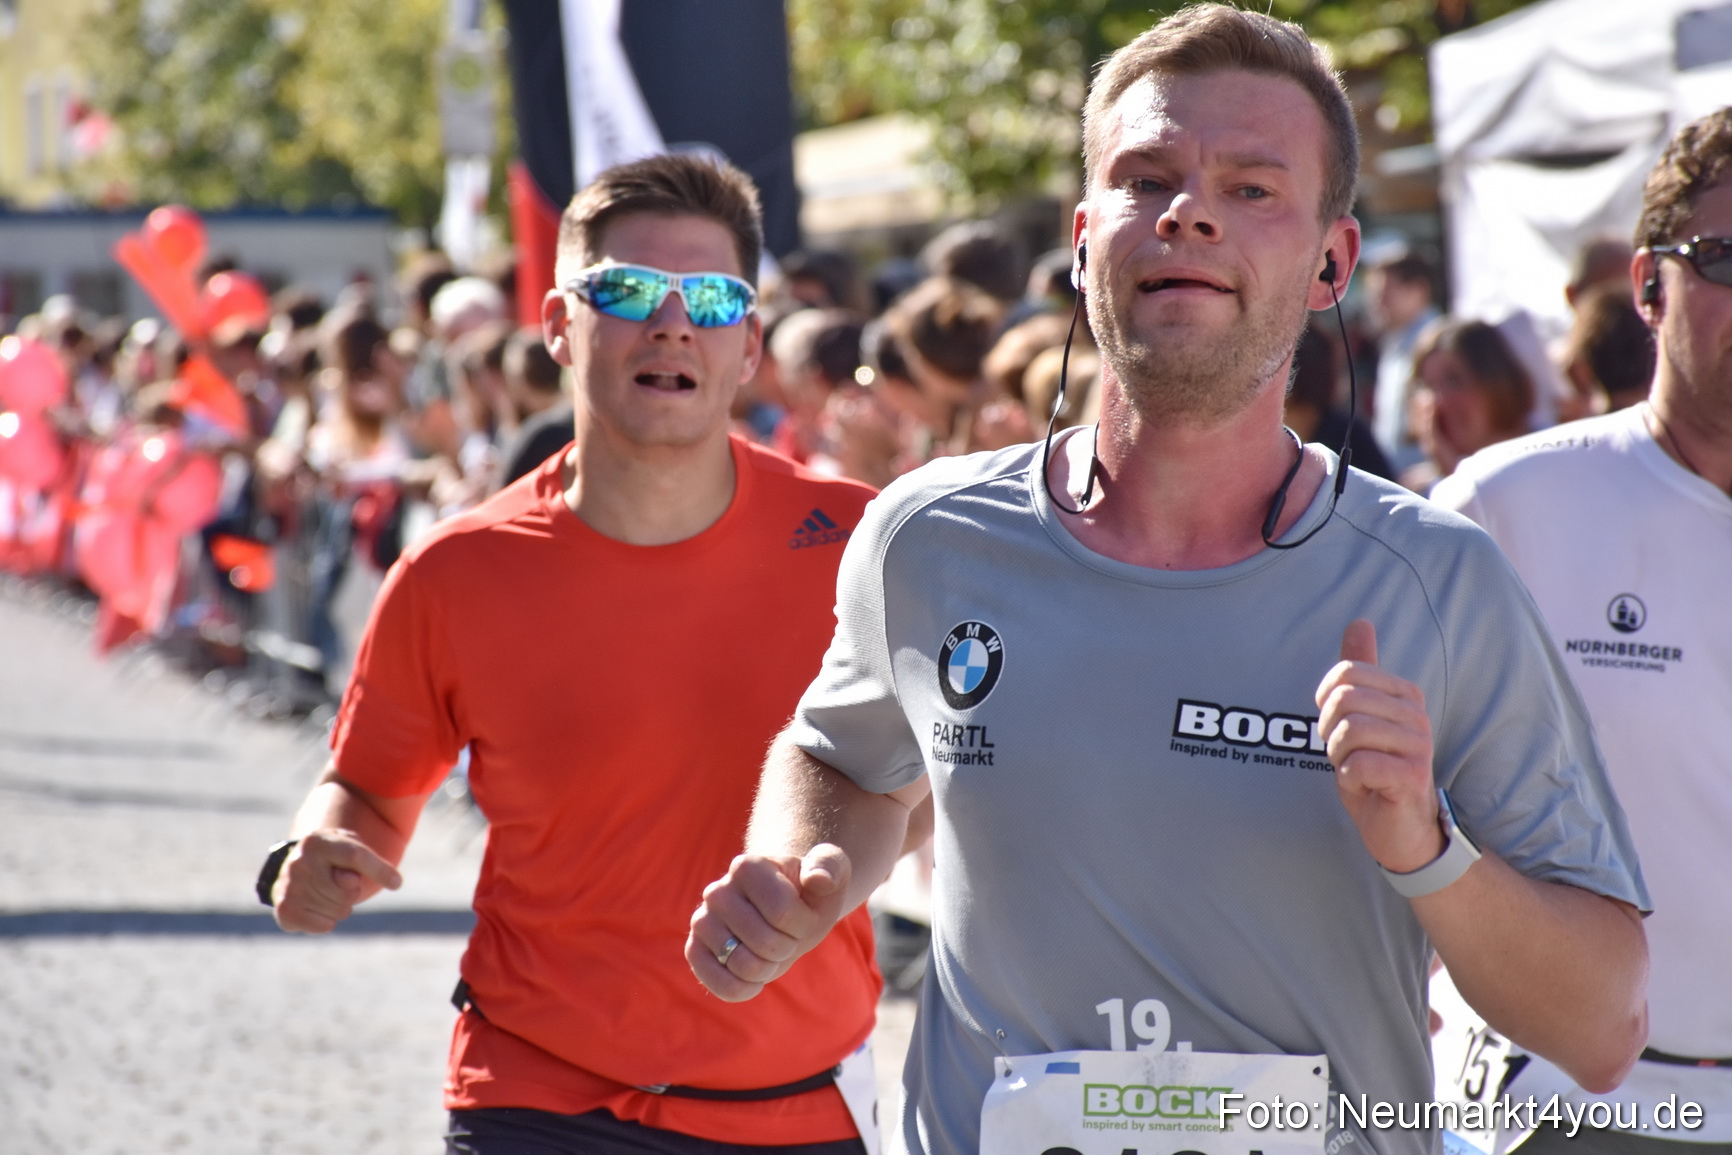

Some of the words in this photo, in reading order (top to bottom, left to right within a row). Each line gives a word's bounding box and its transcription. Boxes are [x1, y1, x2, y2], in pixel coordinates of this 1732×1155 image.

[945, 623, 1001, 654] BMW
[1565, 639, 1683, 662] NÜRNBERGER
[1580, 658, 1667, 673] VERSICHERUNG
[932, 722, 995, 748] PARTL
[932, 745, 994, 766] Neumarkt
[1170, 739, 1228, 759] inspired
[1232, 748, 1249, 764] by
[1253, 753, 1295, 768] smart
[1298, 758, 1335, 773] conc
[1095, 998, 1193, 1052] 19.
[1084, 1084, 1233, 1119] BOCK
[1082, 1119, 1128, 1131] inspired
[1131, 1121, 1145, 1132] by
[1148, 1122, 1182, 1132] smart
